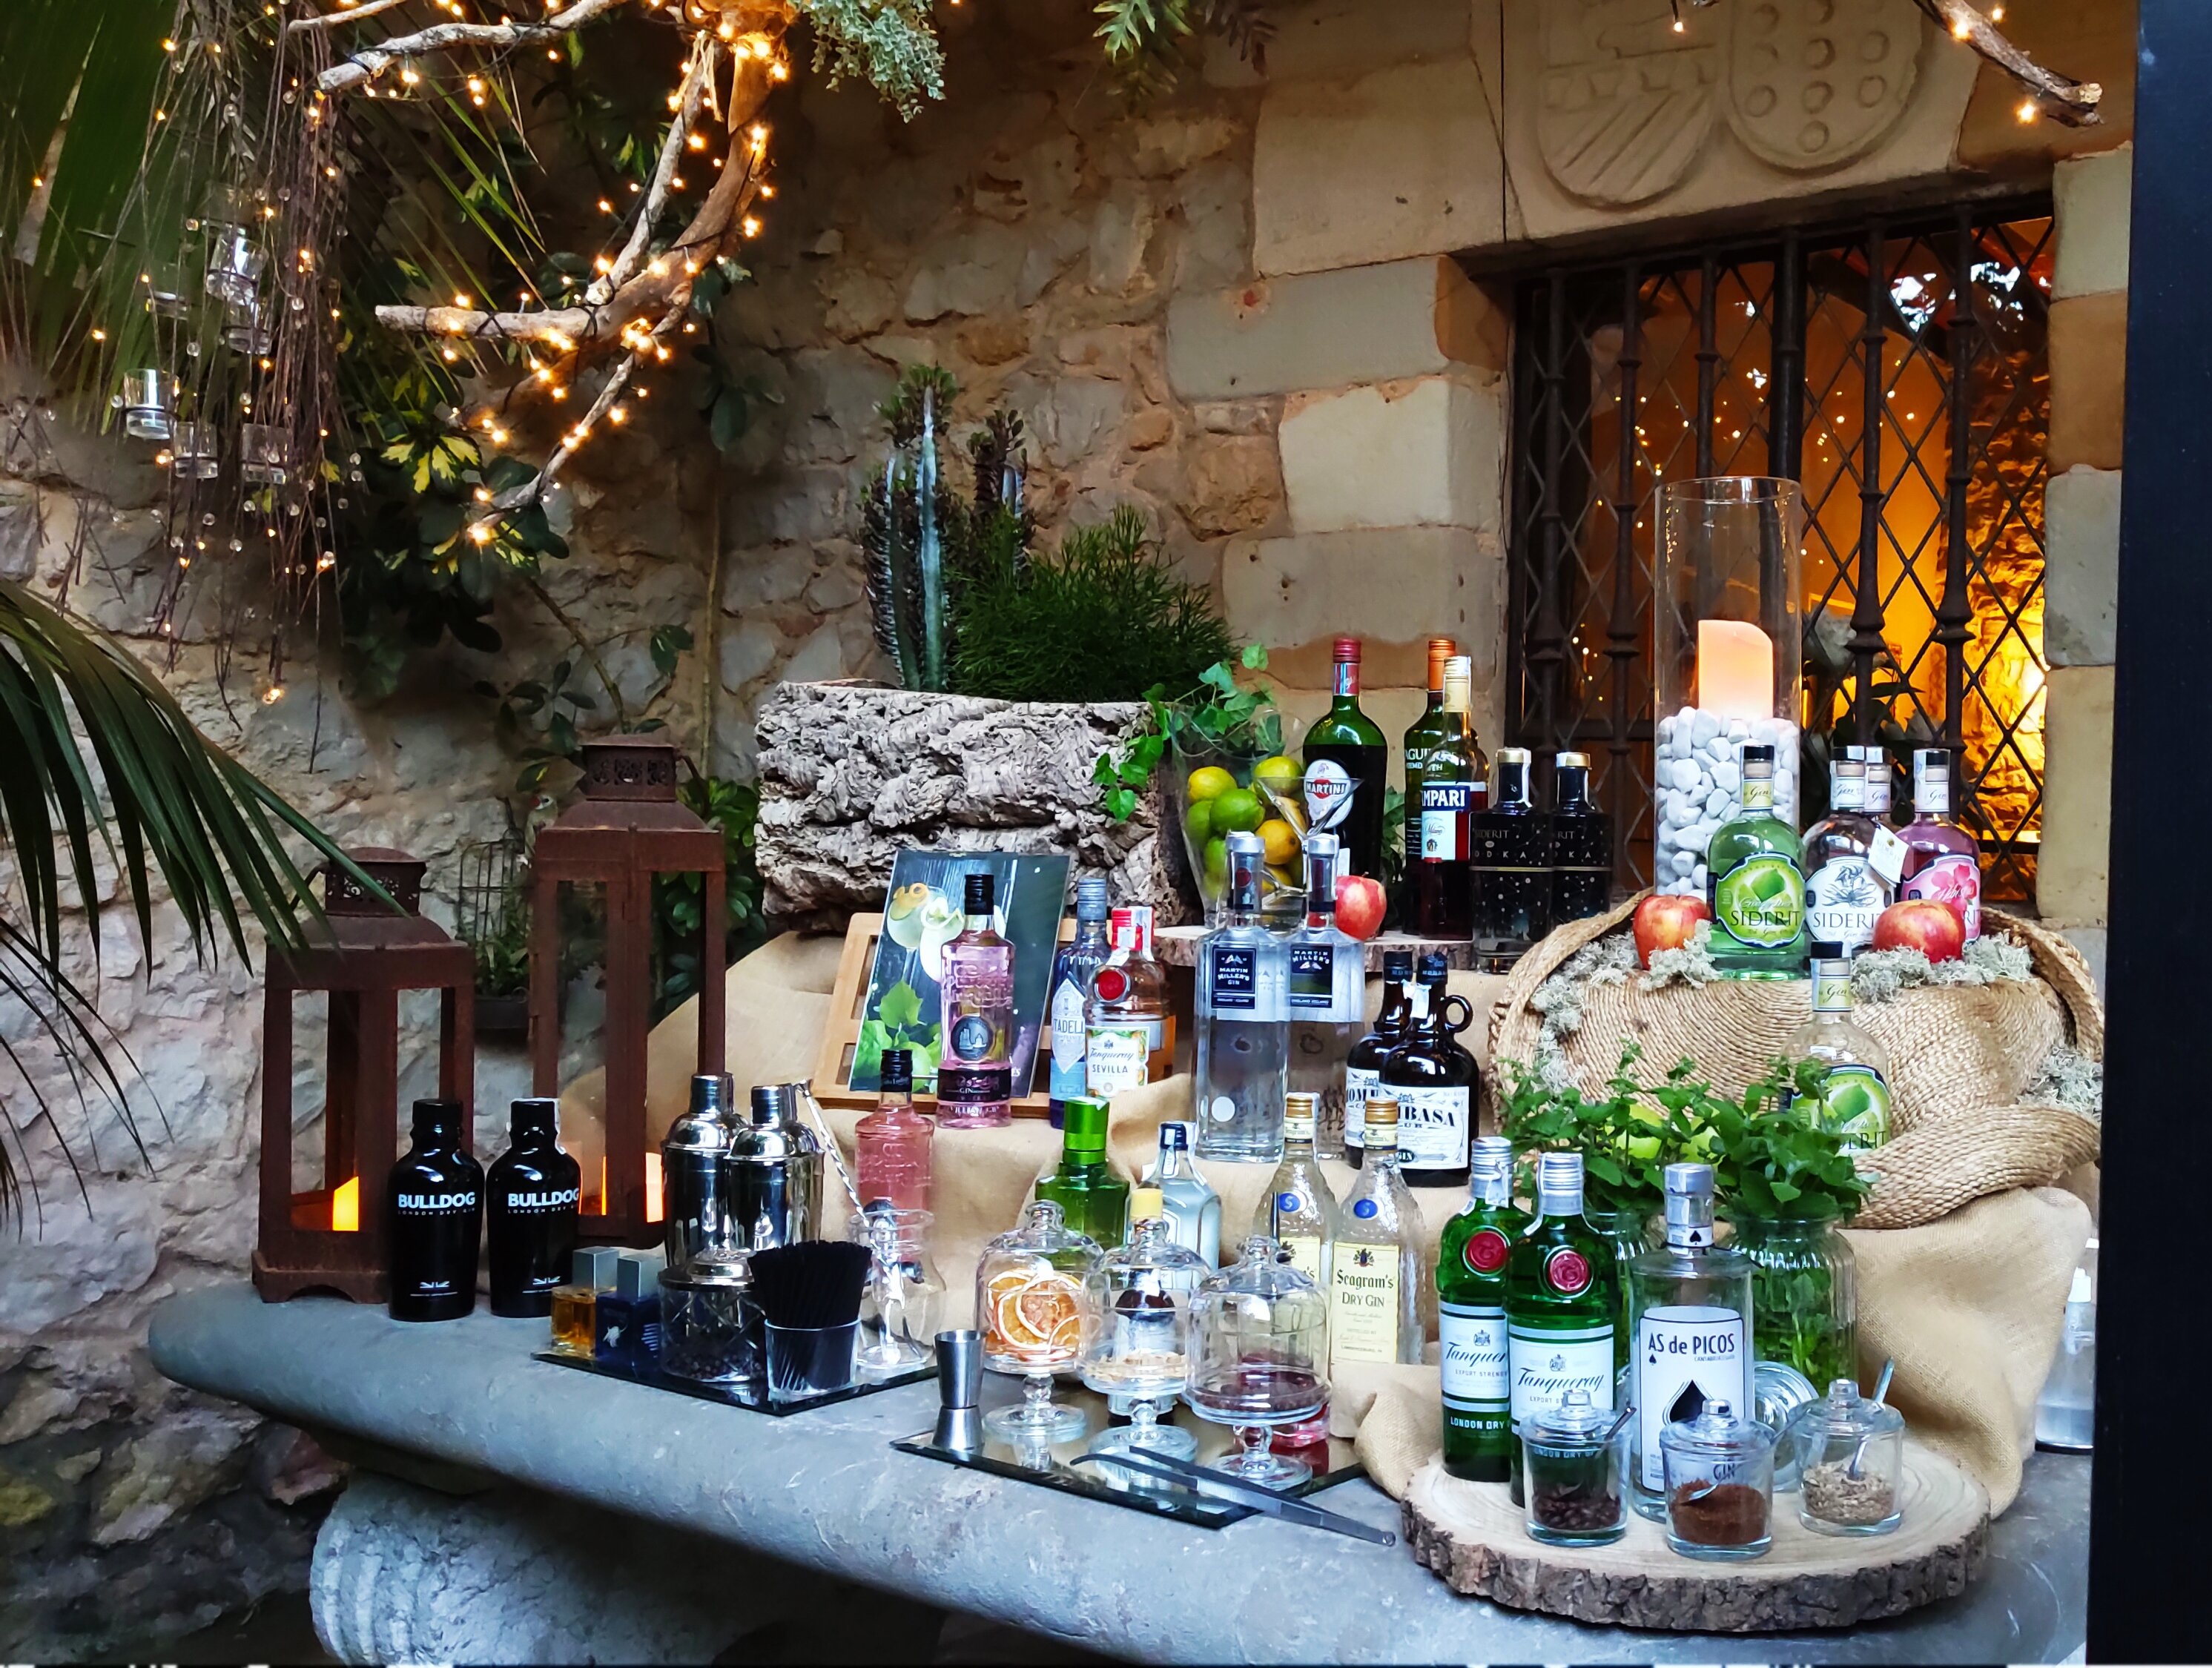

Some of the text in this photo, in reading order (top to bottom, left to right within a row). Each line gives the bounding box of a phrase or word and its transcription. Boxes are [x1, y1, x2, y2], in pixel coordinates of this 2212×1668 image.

[1306, 783, 1345, 795] MARTINI
[1421, 790, 1465, 807] MPARI
[1730, 910, 1800, 926] SIDERIT
[1292, 955, 1330, 964] MILLER'S
[1218, 973, 1249, 982] MILLER'S
[1090, 1048, 1134, 1061] Tanqueray
[1092, 1064, 1128, 1073] SEVILLA
[398, 1192, 475, 1208] BULLDOG
[508, 1188, 579, 1207] BULLDOG
[1336, 1268, 1394, 1290] Seagram's
[1342, 1291, 1385, 1308] DRY GIN
[1648, 1332, 1735, 1354] AS de PICOS
[1518, 1367, 1605, 1394] Tanqueray
[1530, 1395, 1552, 1404] EXPORT
[1450, 1416, 1483, 1429] LONDON
[1486, 1420, 1505, 1429] DRY
